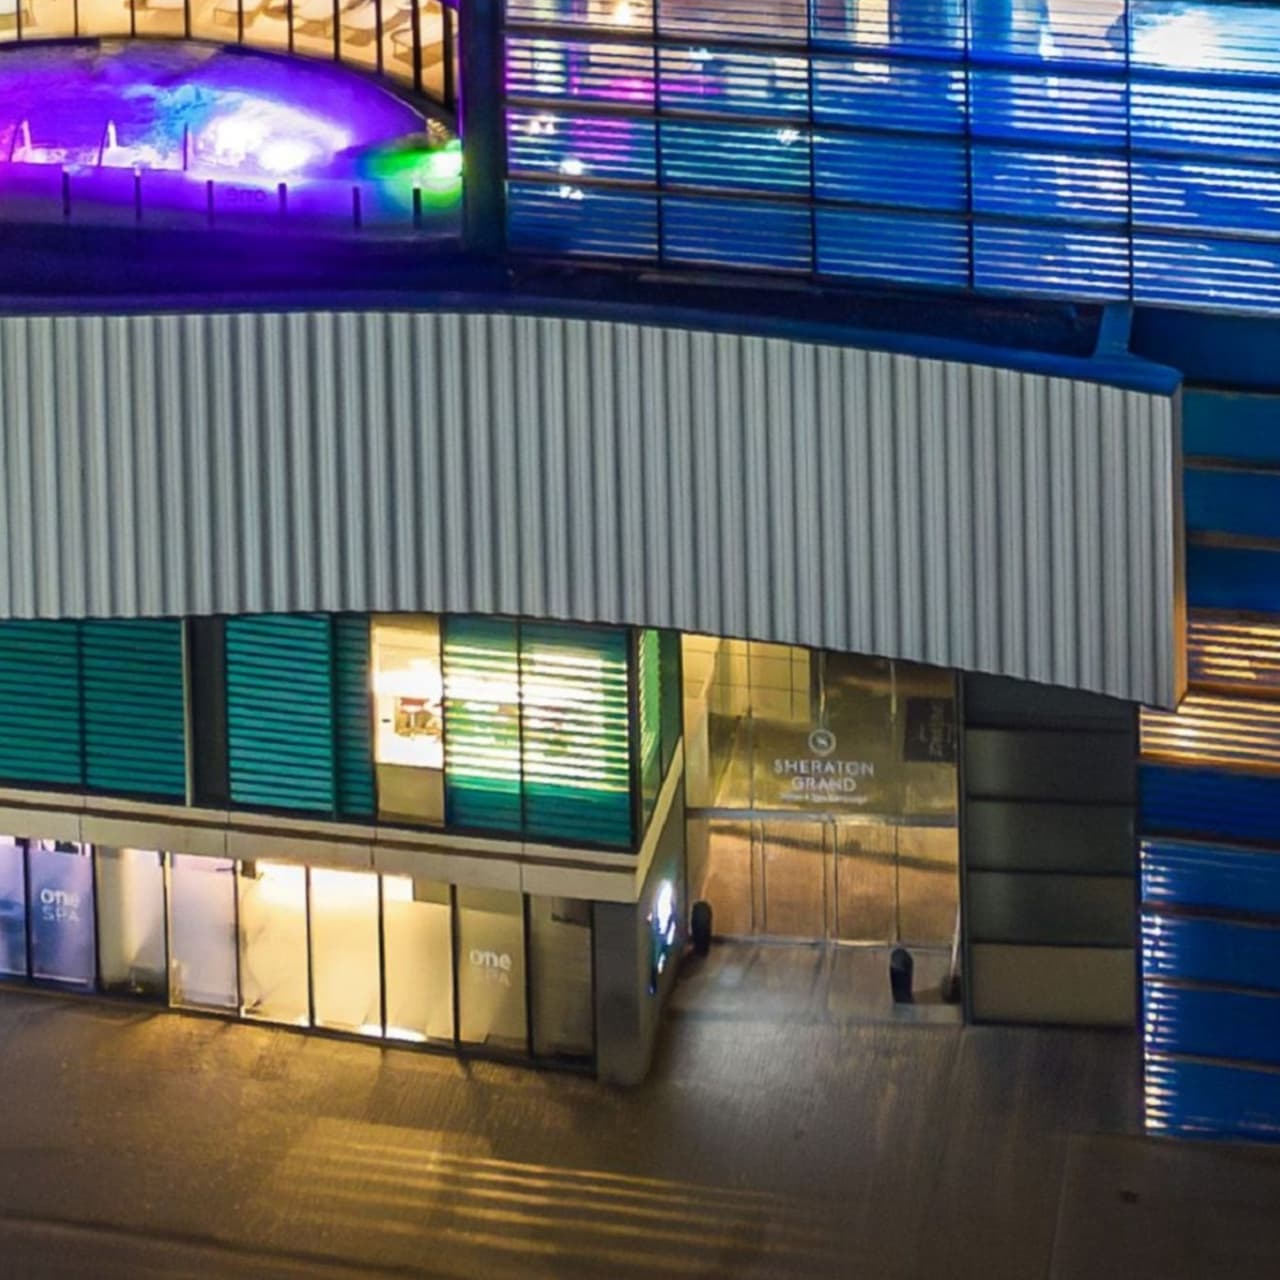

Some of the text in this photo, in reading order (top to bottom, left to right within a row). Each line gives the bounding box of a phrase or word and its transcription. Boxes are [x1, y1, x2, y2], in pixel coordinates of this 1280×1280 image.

[774, 759, 874, 777] SHERATON
[792, 776, 857, 792] GRAND
[40, 888, 81, 909] one
[41, 904, 80, 923] SPA
[469, 949, 512, 971] one
